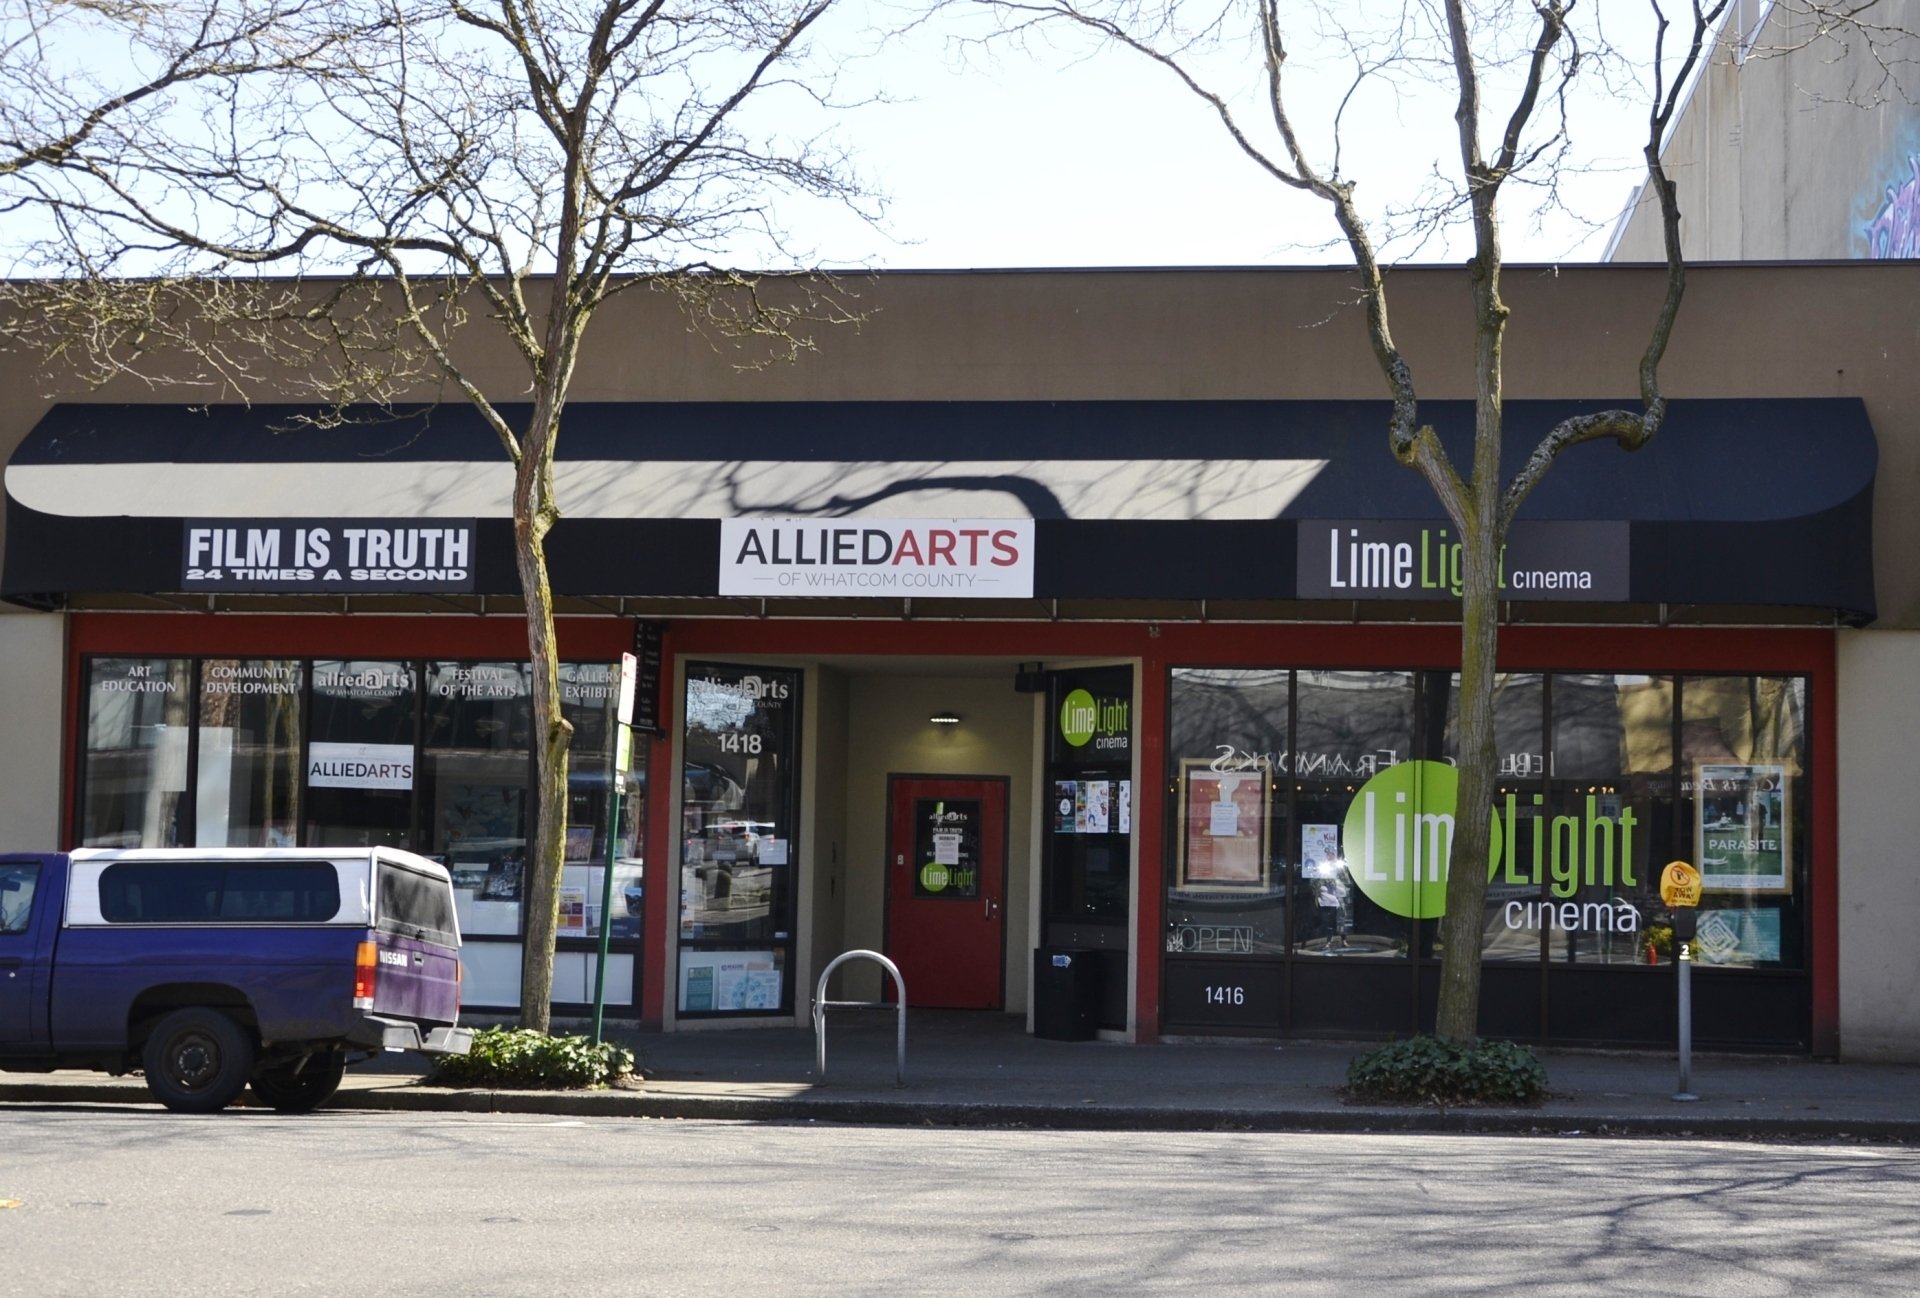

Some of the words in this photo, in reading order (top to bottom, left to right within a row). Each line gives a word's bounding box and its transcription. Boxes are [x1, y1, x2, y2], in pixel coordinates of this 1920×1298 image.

[188, 528, 281, 567] FILM
[294, 527, 331, 568] IS
[343, 528, 469, 568] TRUTH
[735, 528, 1019, 567] ALLIEDARTS
[185, 568, 223, 581] 24
[230, 568, 315, 581] TIMES
[322, 569, 342, 581] A
[350, 569, 468, 581] SECOND
[778, 572, 801, 586] OF
[804, 573, 897, 587] WHATCOM
[902, 573, 977, 588] COUNTY
[1512, 570, 1592, 590] cinema
[128, 666, 151, 677] ART
[211, 666, 292, 679] COMMUNITY
[452, 669, 504, 681] FESTIVAL
[566, 671, 621, 683] GALLERY
[102, 681, 177, 692] EDUCATION
[206, 682, 296, 694] DEVELOPMENT
[337, 689, 373, 697] WHATCOM
[439, 685, 458, 696] OF
[461, 685, 483, 696] THE
[487, 686, 517, 697] ARTS
[565, 686, 621, 699] EXHIBITS
[718, 733, 762, 754] 1418
[1096, 736, 1128, 750] cinema
[310, 762, 412, 779] ALLIEDARTS
[1708, 839, 1777, 851] PARASITE
[1673, 892, 1695, 900] AWAY
[1505, 900, 1638, 933] cinema
[1181, 927, 1250, 951] OPEN
[1682, 944, 1690, 955] 2
[379, 950, 408, 967] NISSAN
[1205, 986, 1244, 1005] 1416
